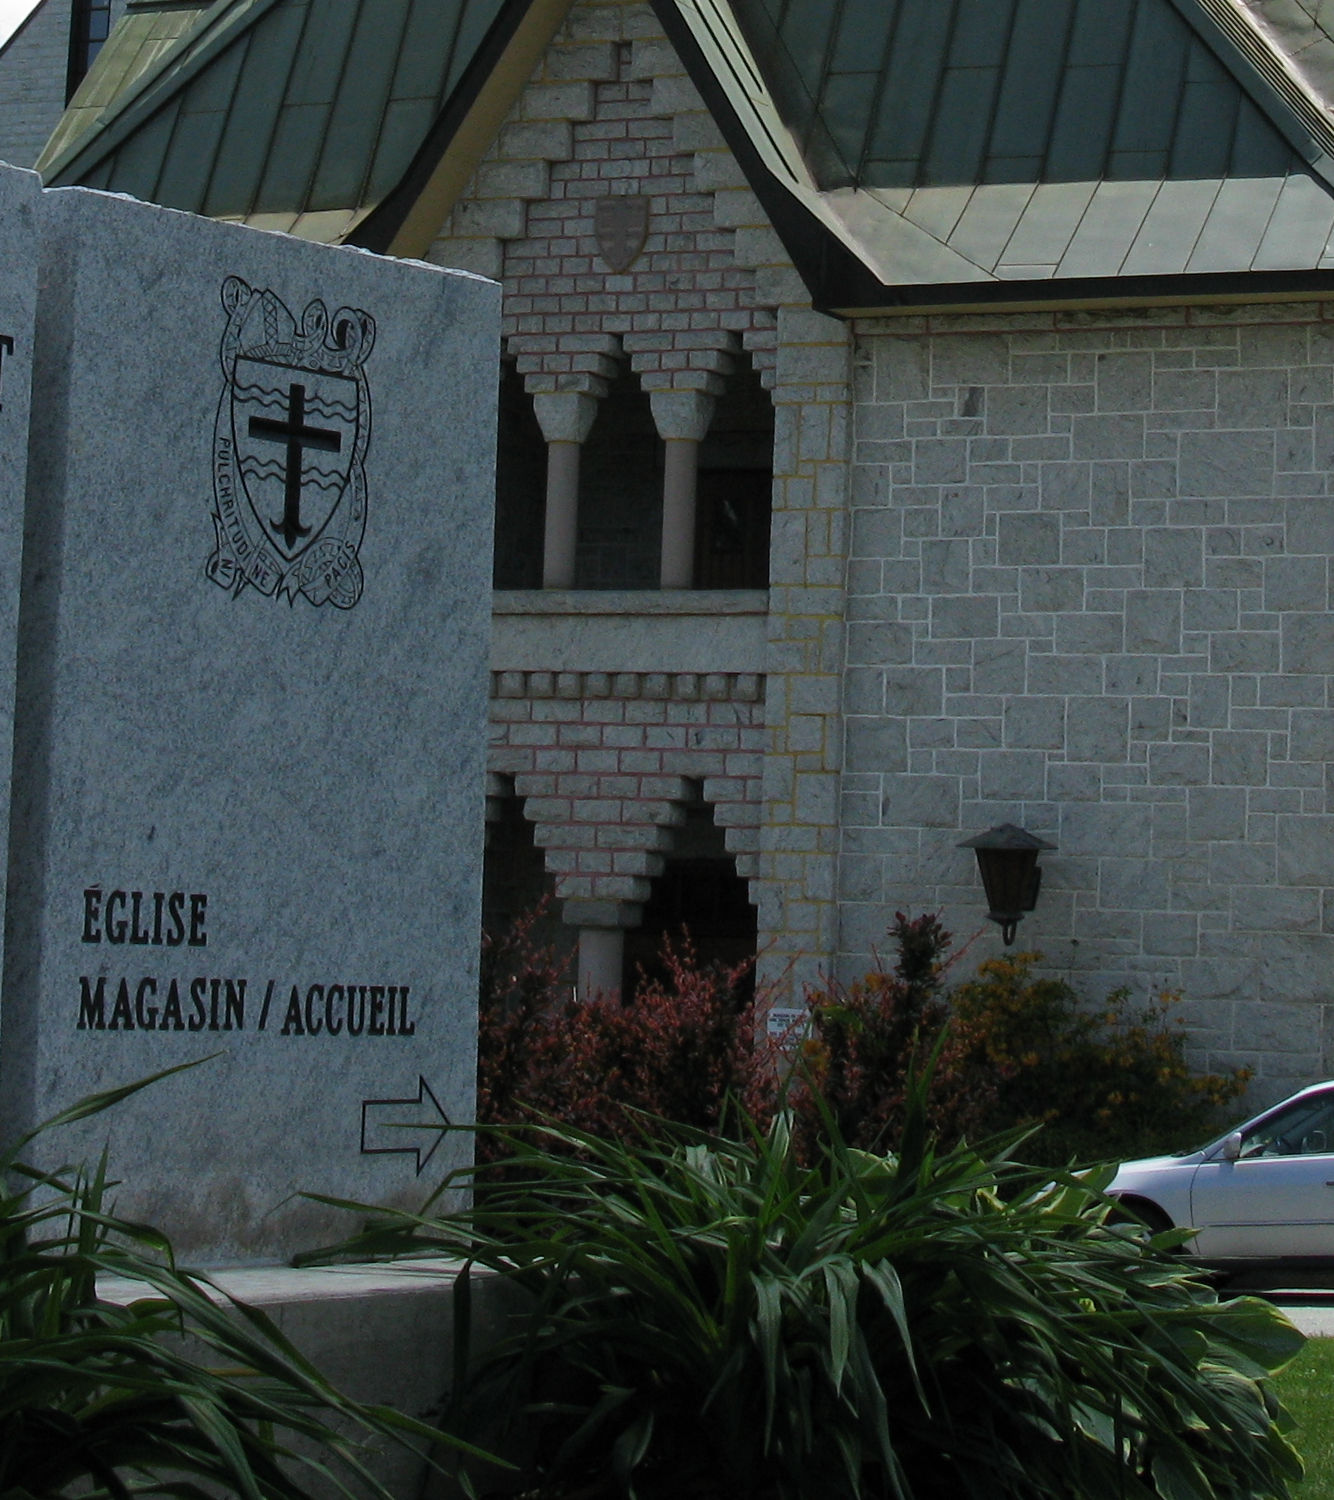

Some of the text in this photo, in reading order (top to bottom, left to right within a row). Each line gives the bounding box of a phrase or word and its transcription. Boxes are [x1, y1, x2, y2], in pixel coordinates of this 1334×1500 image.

[323, 540, 357, 589] PACIS
[81, 884, 208, 948] ÉGLISE
[76, 976, 248, 1033] MAGASIN
[280, 983, 416, 1038] ACCUEIL
